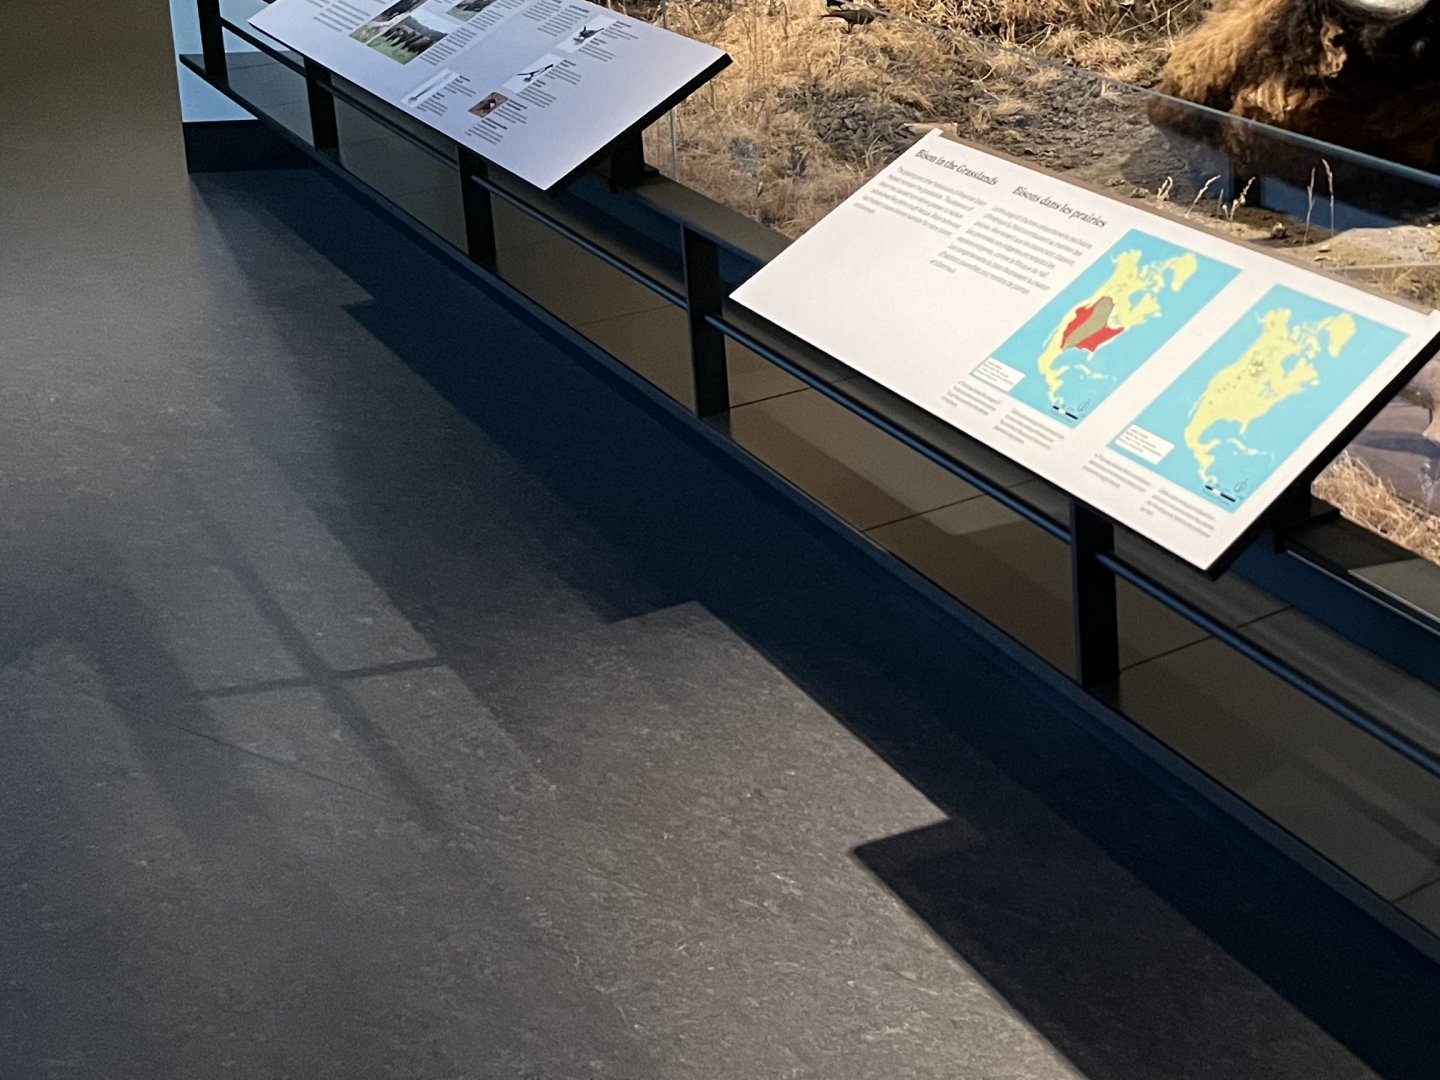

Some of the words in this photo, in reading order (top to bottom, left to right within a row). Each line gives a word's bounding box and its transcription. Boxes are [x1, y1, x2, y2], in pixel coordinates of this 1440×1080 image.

[915, 149, 937, 162] Bison
[935, 156, 946, 166] in
[943, 160, 958, 170] the
[956, 164, 998, 186] Grasslands
[1012, 185, 1041, 202] Bisons
[1039, 196, 1061, 210] dans
[1059, 203, 1074, 214] les
[1068, 210, 1108, 228] prairies
